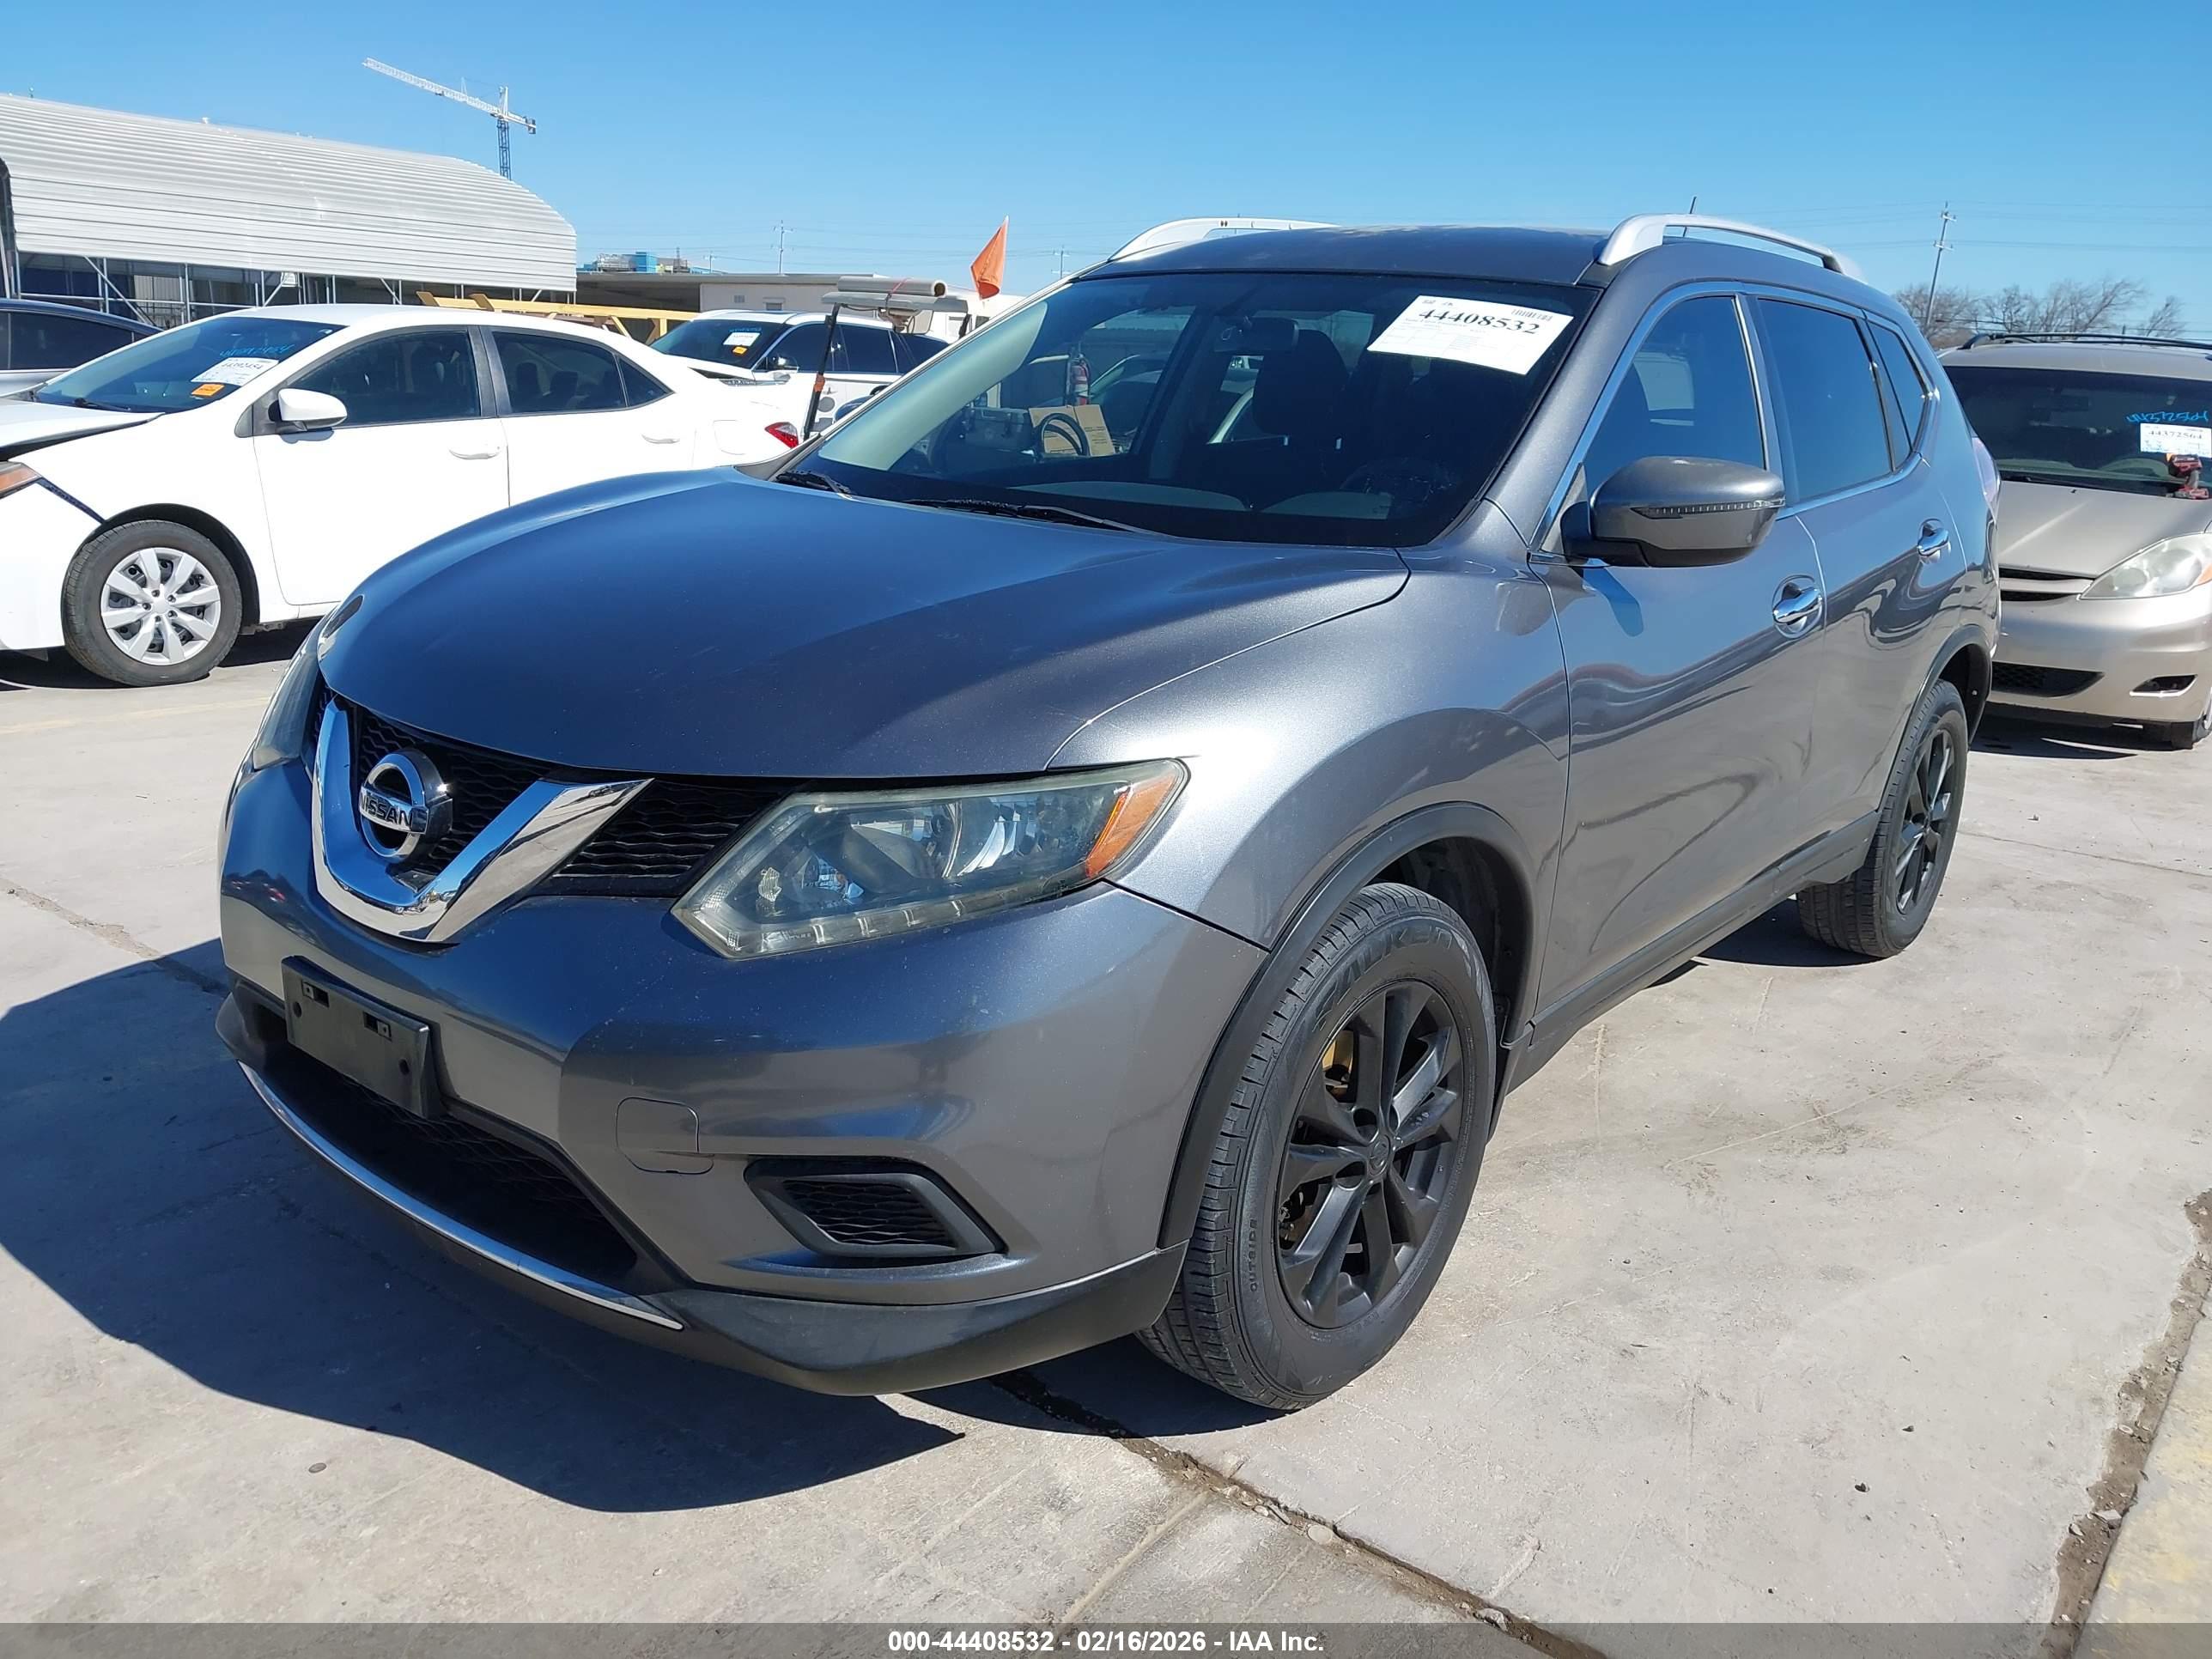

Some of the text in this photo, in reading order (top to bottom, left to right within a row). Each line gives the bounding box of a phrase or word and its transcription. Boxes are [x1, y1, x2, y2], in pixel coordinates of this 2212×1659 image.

[1419, 308, 1540, 335] 44408532
[2148, 430, 2203, 440] 44372564
[358, 790, 413, 827] NISSAN
[1248, 1218, 1258, 1292] OUTSIDE
